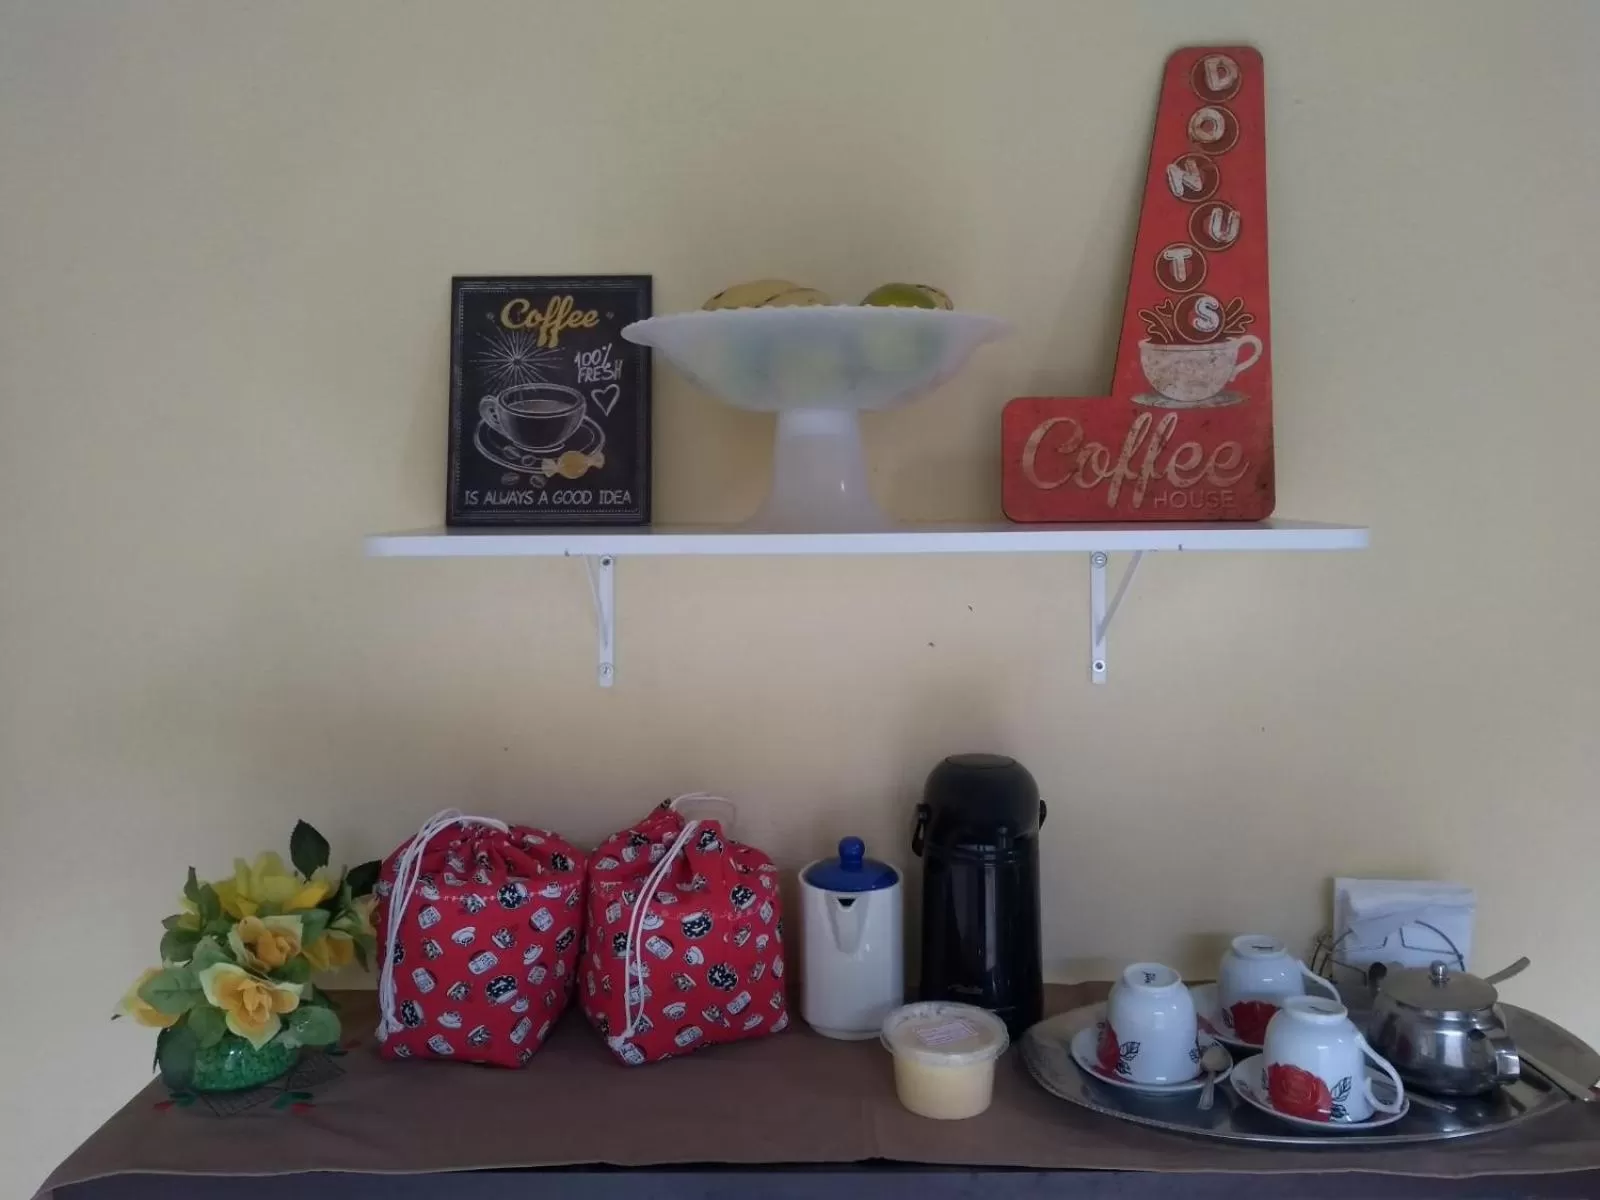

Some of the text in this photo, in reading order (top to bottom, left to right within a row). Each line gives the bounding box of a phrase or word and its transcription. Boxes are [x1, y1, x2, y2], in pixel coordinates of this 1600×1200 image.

[501, 295, 600, 348] Coffee
[574, 343, 613, 368] 100%
[577, 360, 622, 383] FRESH
[1022, 412, 1249, 508] Coffee
[464, 490, 632, 505] IS ALWAYS A GOOD IDEA
[1153, 490, 1236, 509] HOUSE
